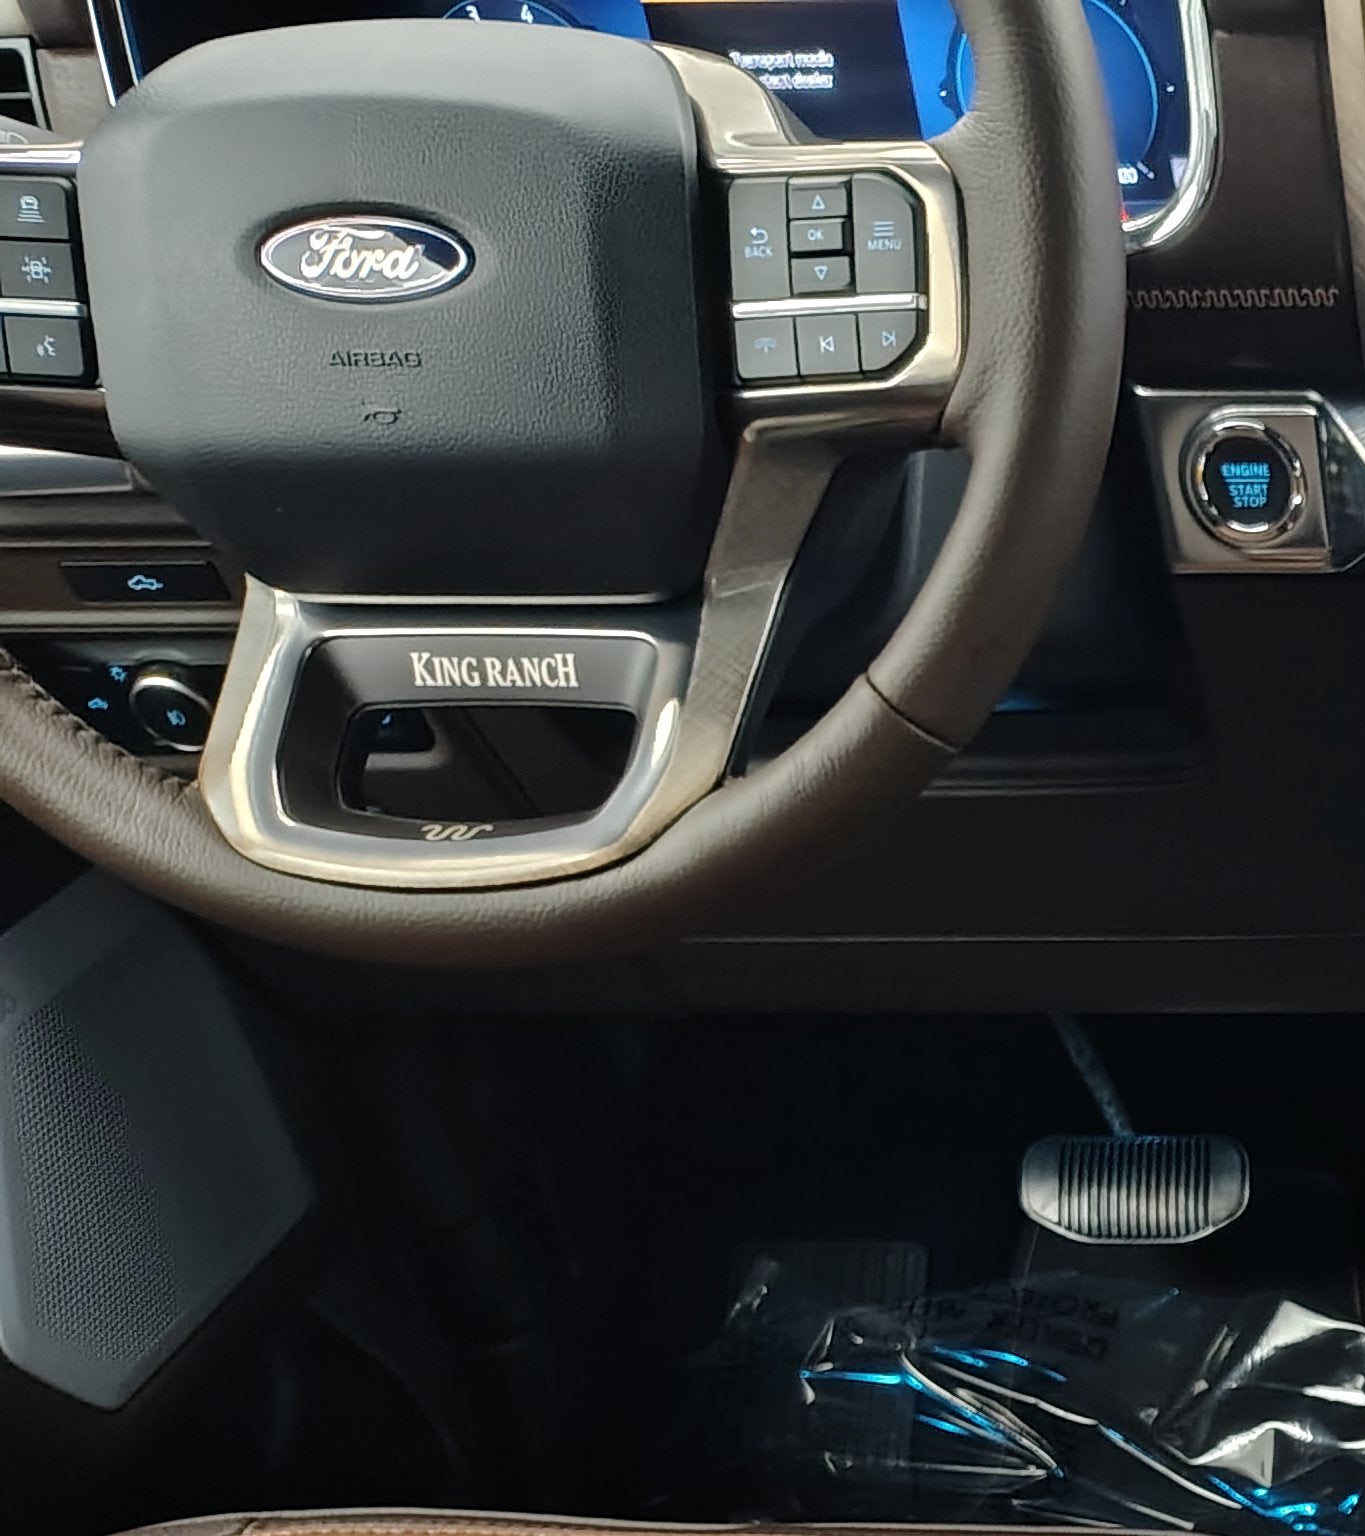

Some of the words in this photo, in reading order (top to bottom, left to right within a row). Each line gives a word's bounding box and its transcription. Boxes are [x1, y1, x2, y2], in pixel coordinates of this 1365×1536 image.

[807, 228, 825, 241] OK
[867, 239, 902, 251] MENU
[301, 226, 421, 280] Ford
[744, 246, 773, 259] BACK
[328, 350, 423, 368] AIRBAG
[1221, 462, 1271, 477] ENGINE
[1228, 484, 1268, 497] START
[1233, 497, 1268, 508] STOP
[410, 651, 482, 687] KING
[484, 652, 580, 688] RANCH
